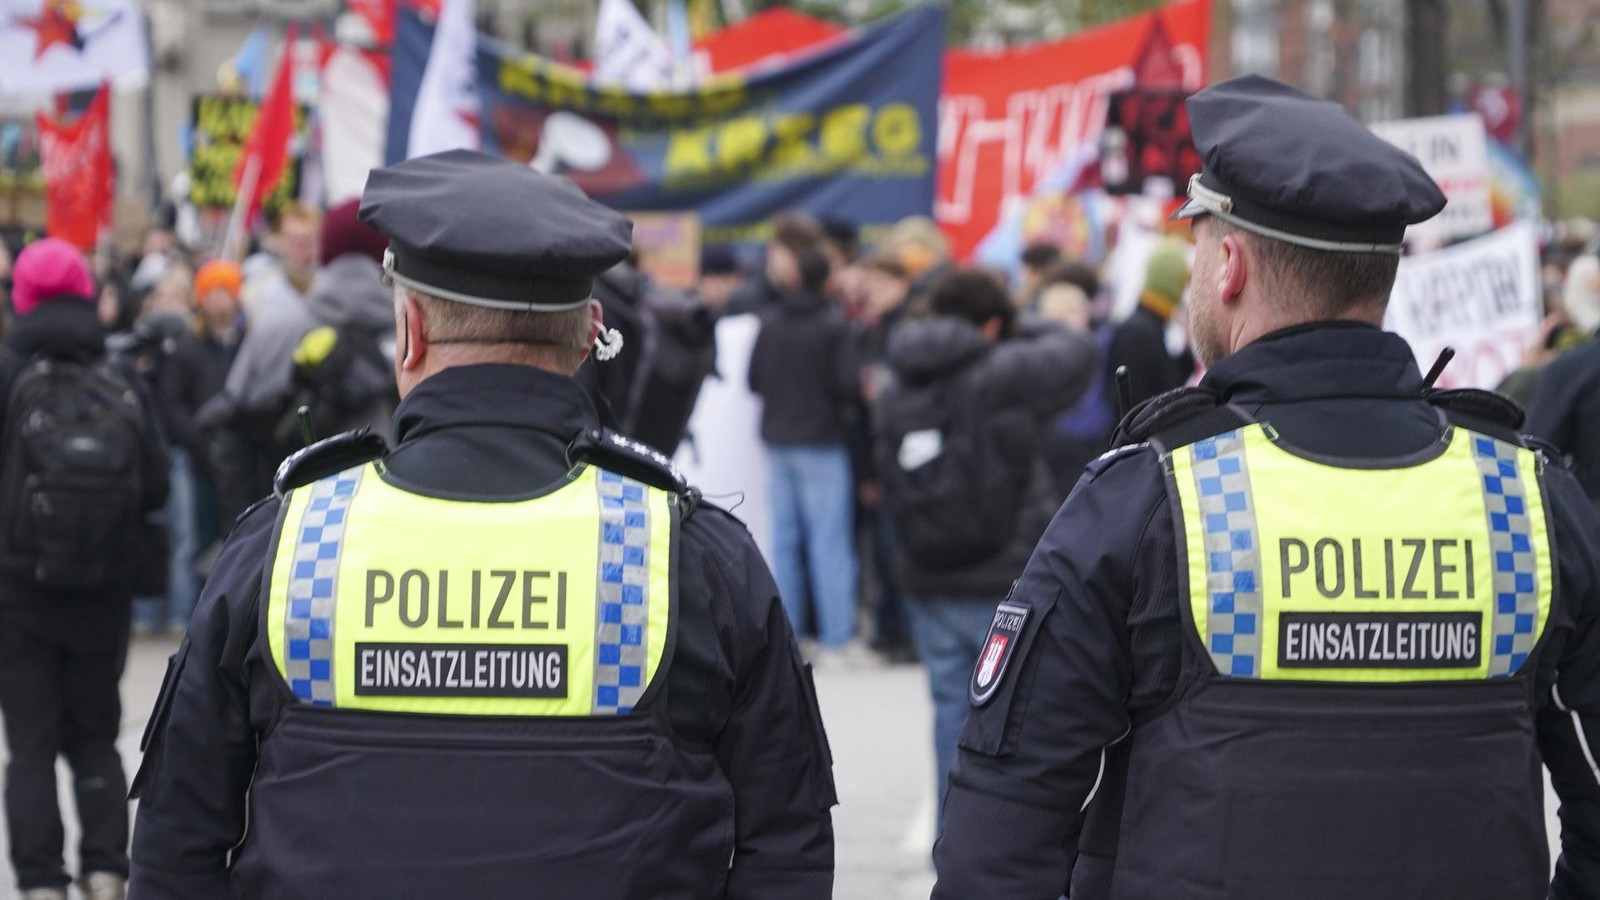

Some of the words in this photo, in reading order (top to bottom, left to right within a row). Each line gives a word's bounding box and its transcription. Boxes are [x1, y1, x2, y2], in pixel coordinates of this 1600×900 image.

[1280, 538, 1475, 599] POLIZEI
[365, 569, 567, 630] POLIZEI
[996, 612, 1021, 632] POLIZEI
[1286, 622, 1476, 661] EINSATZLEITUNG
[361, 649, 562, 689] EINSATZLEITUNG
